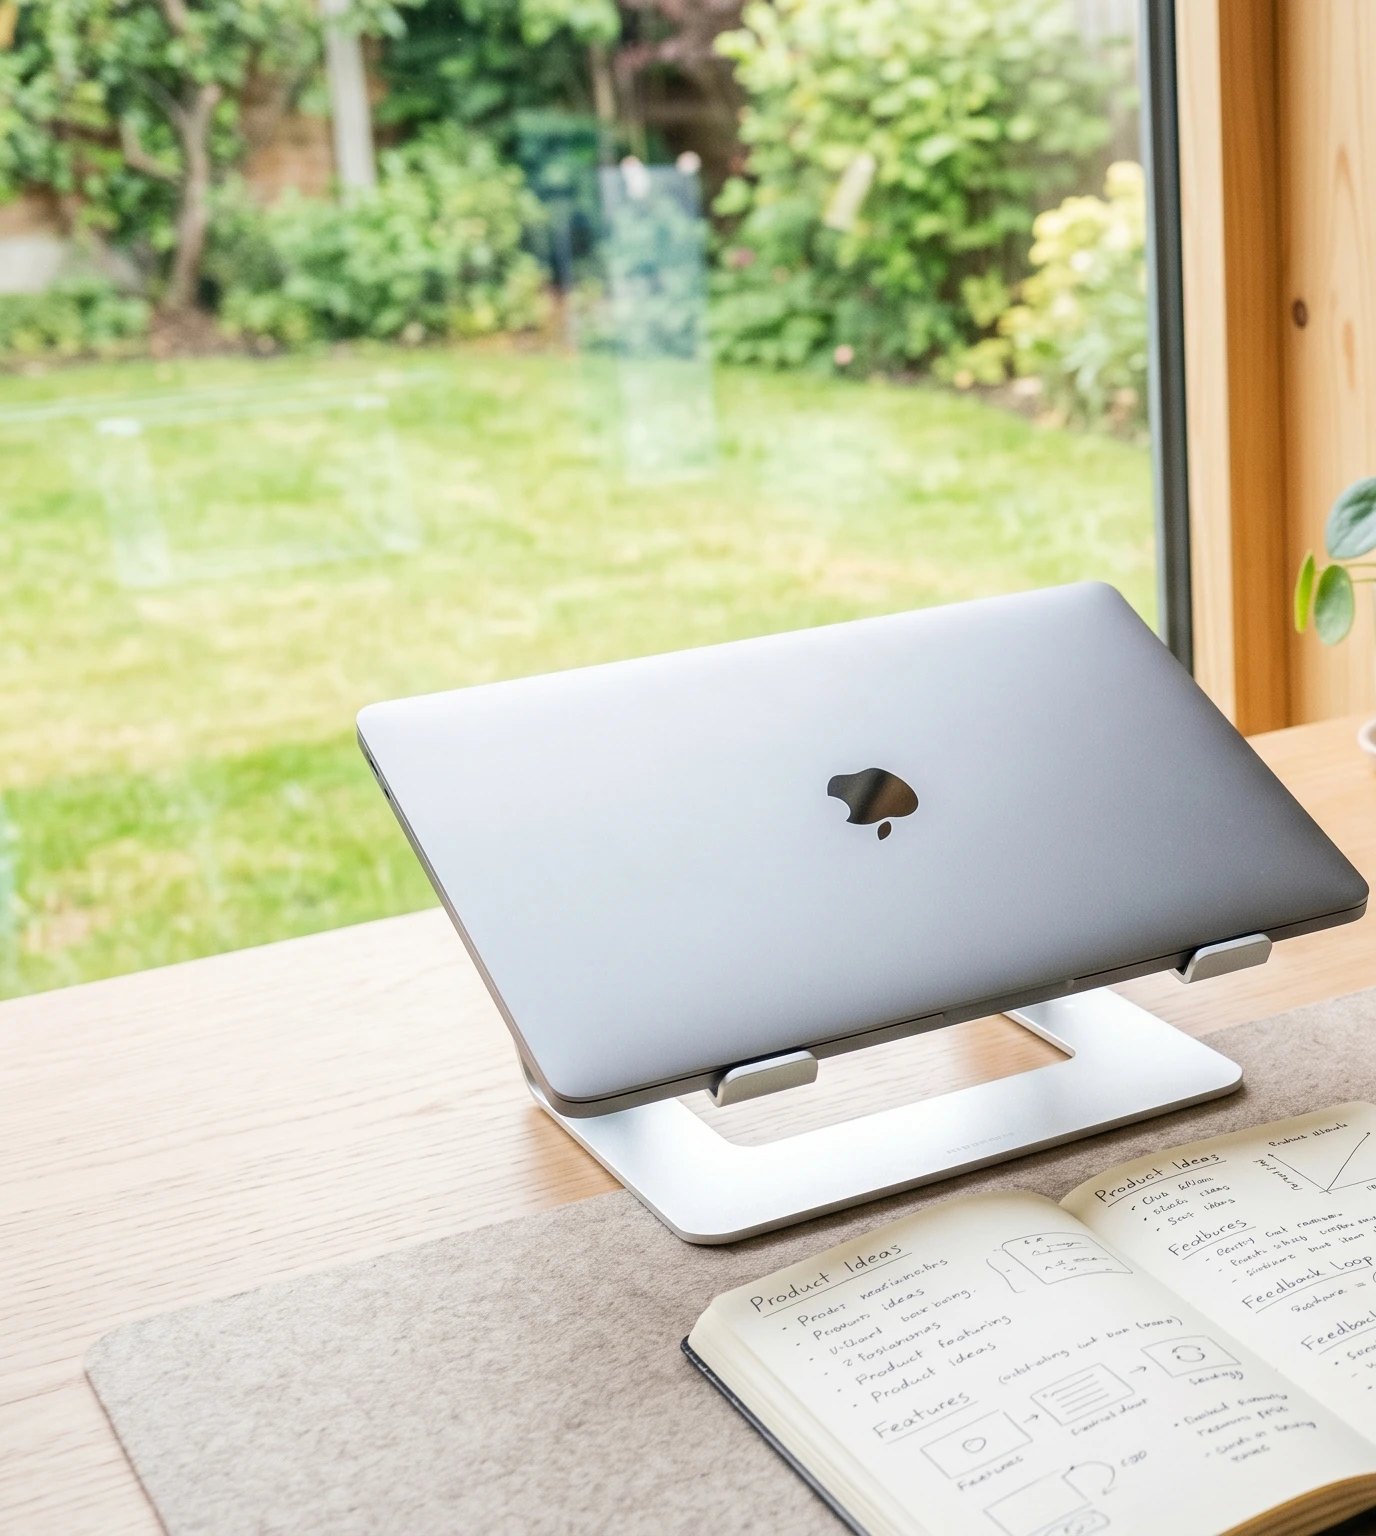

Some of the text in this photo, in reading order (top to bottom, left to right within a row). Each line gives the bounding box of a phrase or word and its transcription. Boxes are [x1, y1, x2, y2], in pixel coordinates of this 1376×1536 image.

[1094, 1168, 1163, 1202] Product
[1172, 1153, 1220, 1170] Ideas
[750, 1244, 902, 1312] Product Ideas
[881, 1288, 925, 1311] ideas
[1242, 1268, 1327, 1309] Feedback
[1329, 1255, 1374, 1271] Loop
[855, 1349, 923, 1386] Product
[871, 1367, 937, 1403] Product
[949, 1342, 997, 1367] ideas
[873, 1392, 970, 1439] Features
